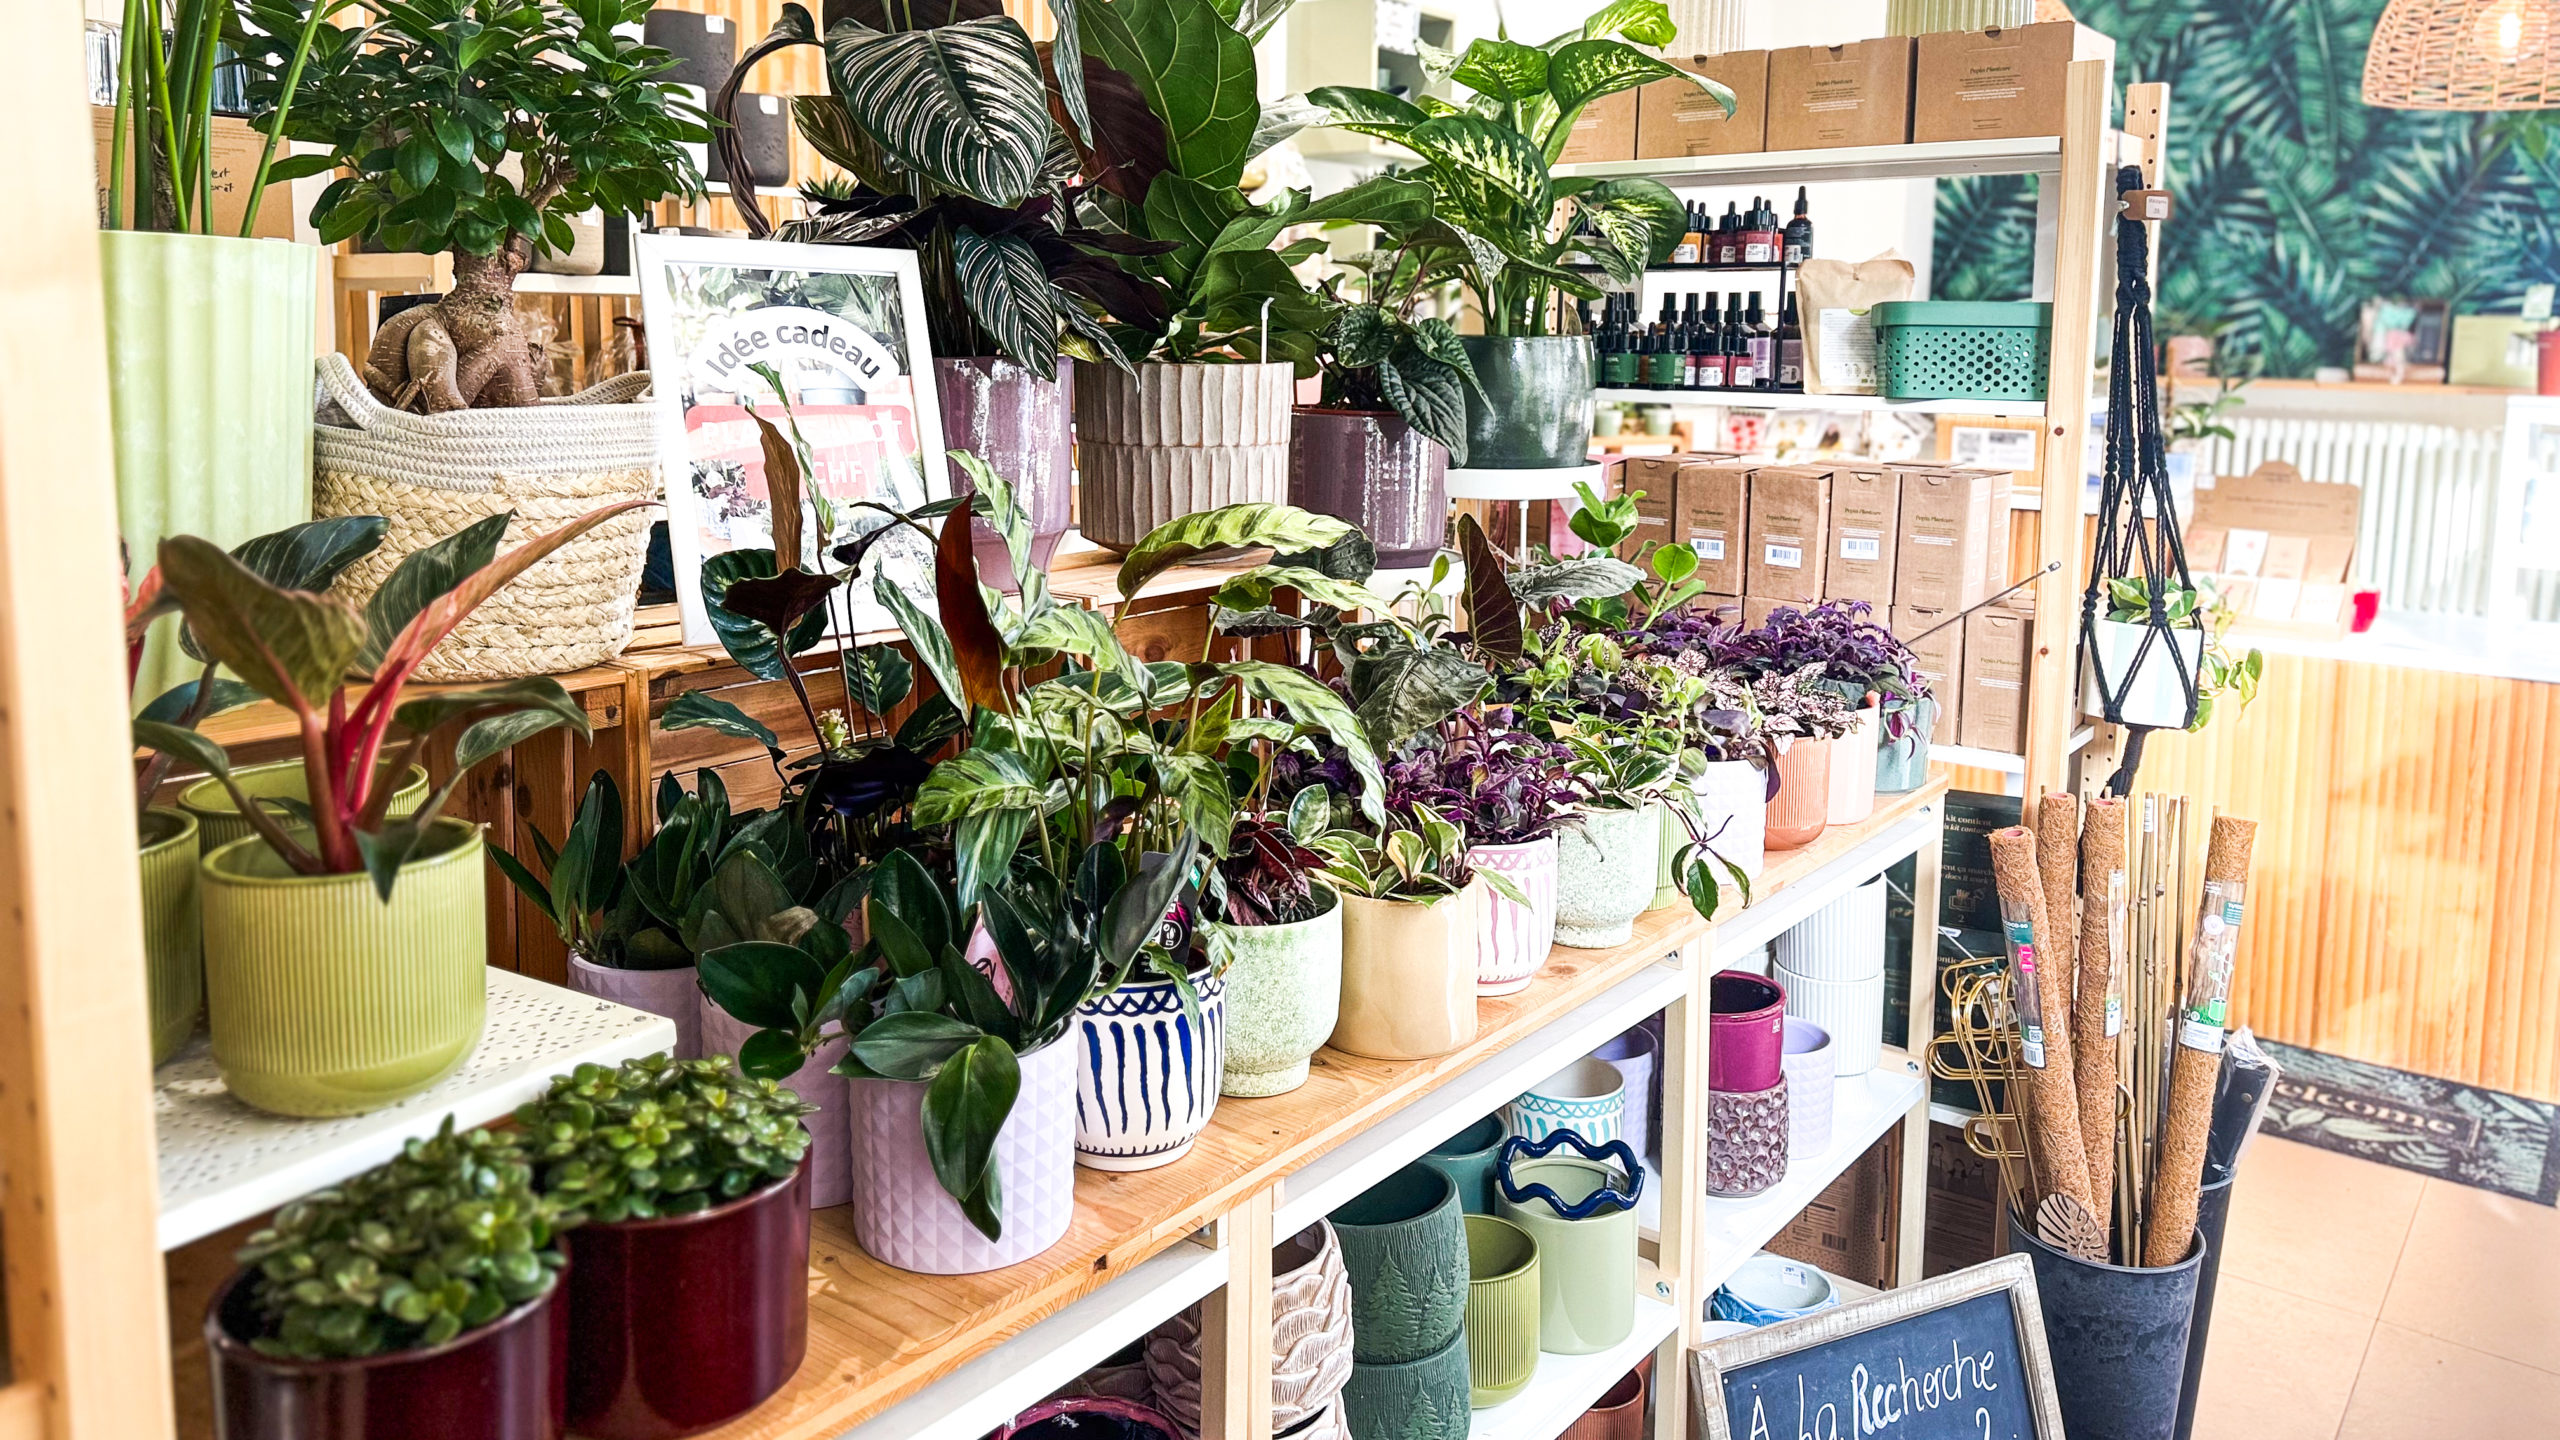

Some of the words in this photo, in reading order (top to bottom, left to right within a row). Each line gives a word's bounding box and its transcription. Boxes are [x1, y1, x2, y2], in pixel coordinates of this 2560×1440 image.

[705, 330, 770, 378] Idée
[776, 325, 880, 379] cadeau
[2275, 1083, 2457, 1134] elcome
[1851, 1339, 1998, 1439] Recherche
